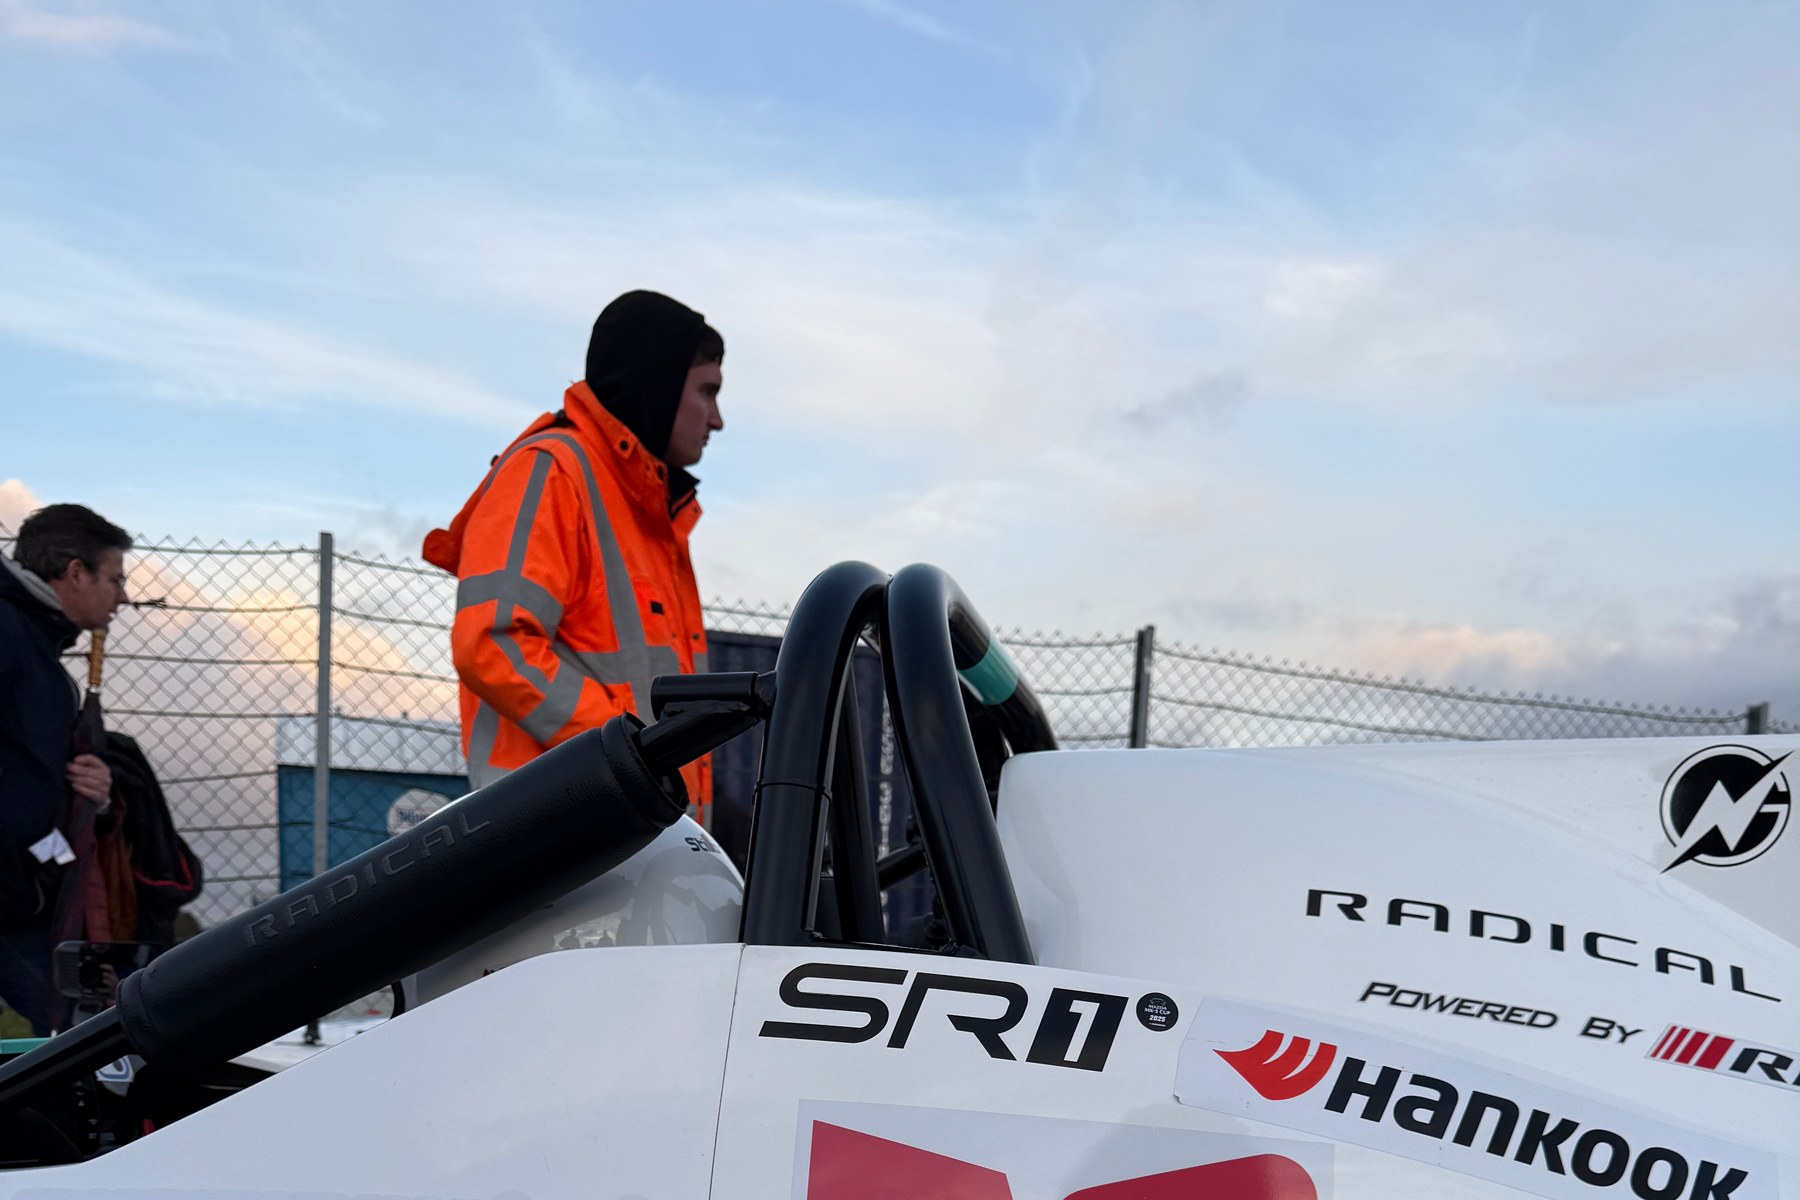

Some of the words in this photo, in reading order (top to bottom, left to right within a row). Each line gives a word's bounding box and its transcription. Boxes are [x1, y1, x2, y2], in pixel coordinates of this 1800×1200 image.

[243, 812, 491, 947] RADICAL
[1305, 888, 1782, 1002] RADICAL
[758, 962, 1129, 1073] SR1
[1149, 1014, 1166, 1022] 2025
[1357, 980, 1558, 1030] POWERED
[1578, 1015, 1644, 1044] BY
[1728, 1047, 1800, 1087] R
